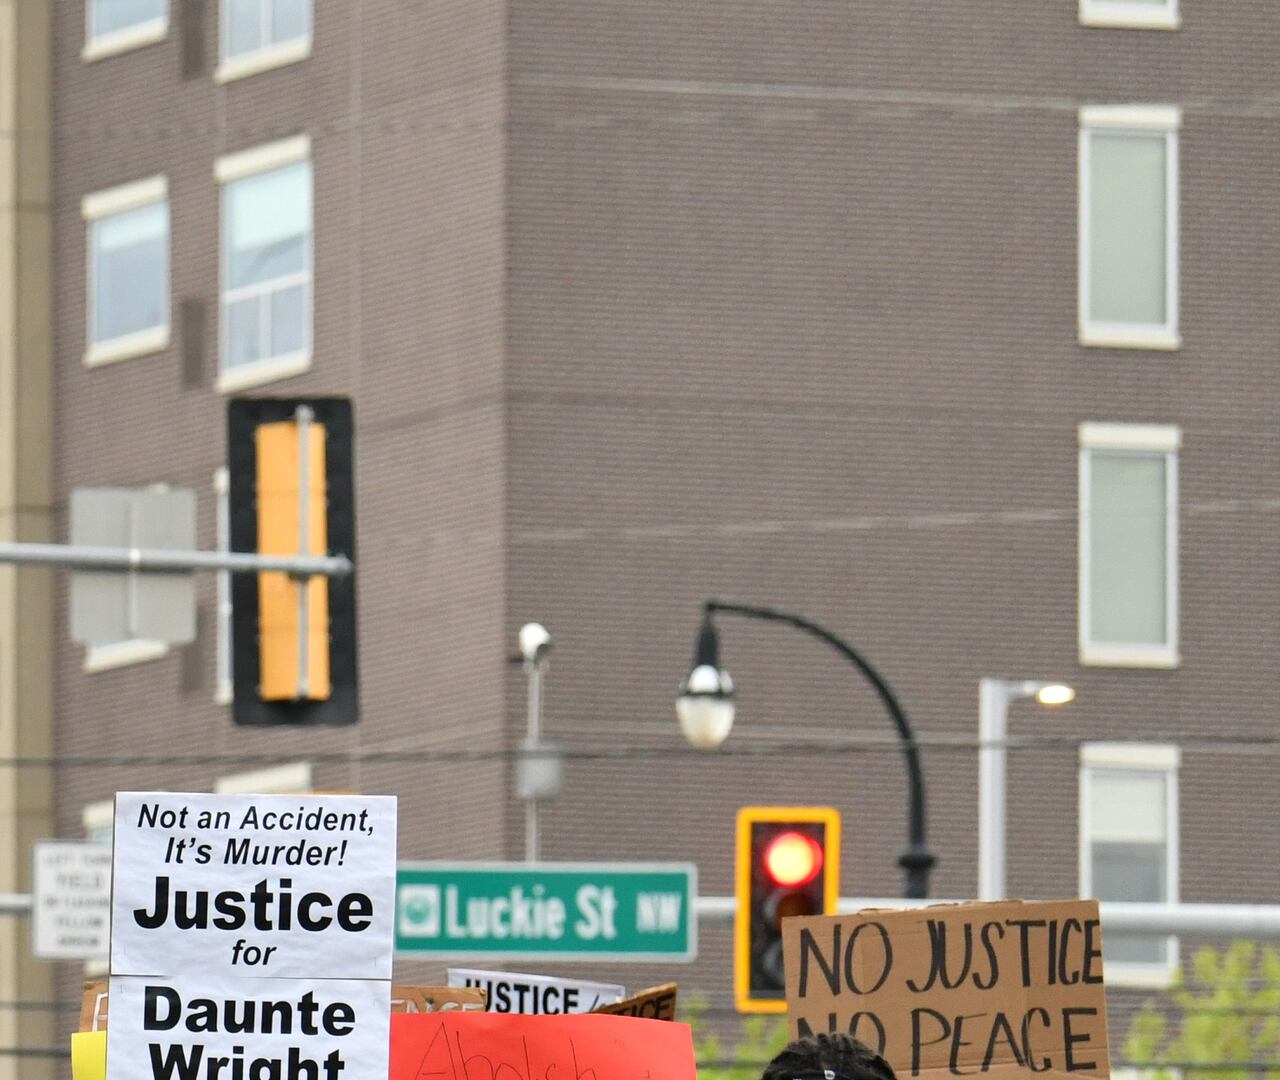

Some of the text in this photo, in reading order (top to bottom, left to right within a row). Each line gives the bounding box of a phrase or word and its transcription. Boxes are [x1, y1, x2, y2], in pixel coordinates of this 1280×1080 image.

[138, 804, 375, 836] Not an Accident,
[164, 837, 348, 867] It's Murder!
[133, 876, 374, 932] Justice
[445, 884, 682, 940] Luckie St NW
[231, 940, 277, 966] for
[798, 918, 1104, 997] NO JUSTICE
[143, 985, 356, 1036] Daunte
[911, 1007, 1098, 1077] PEACE
